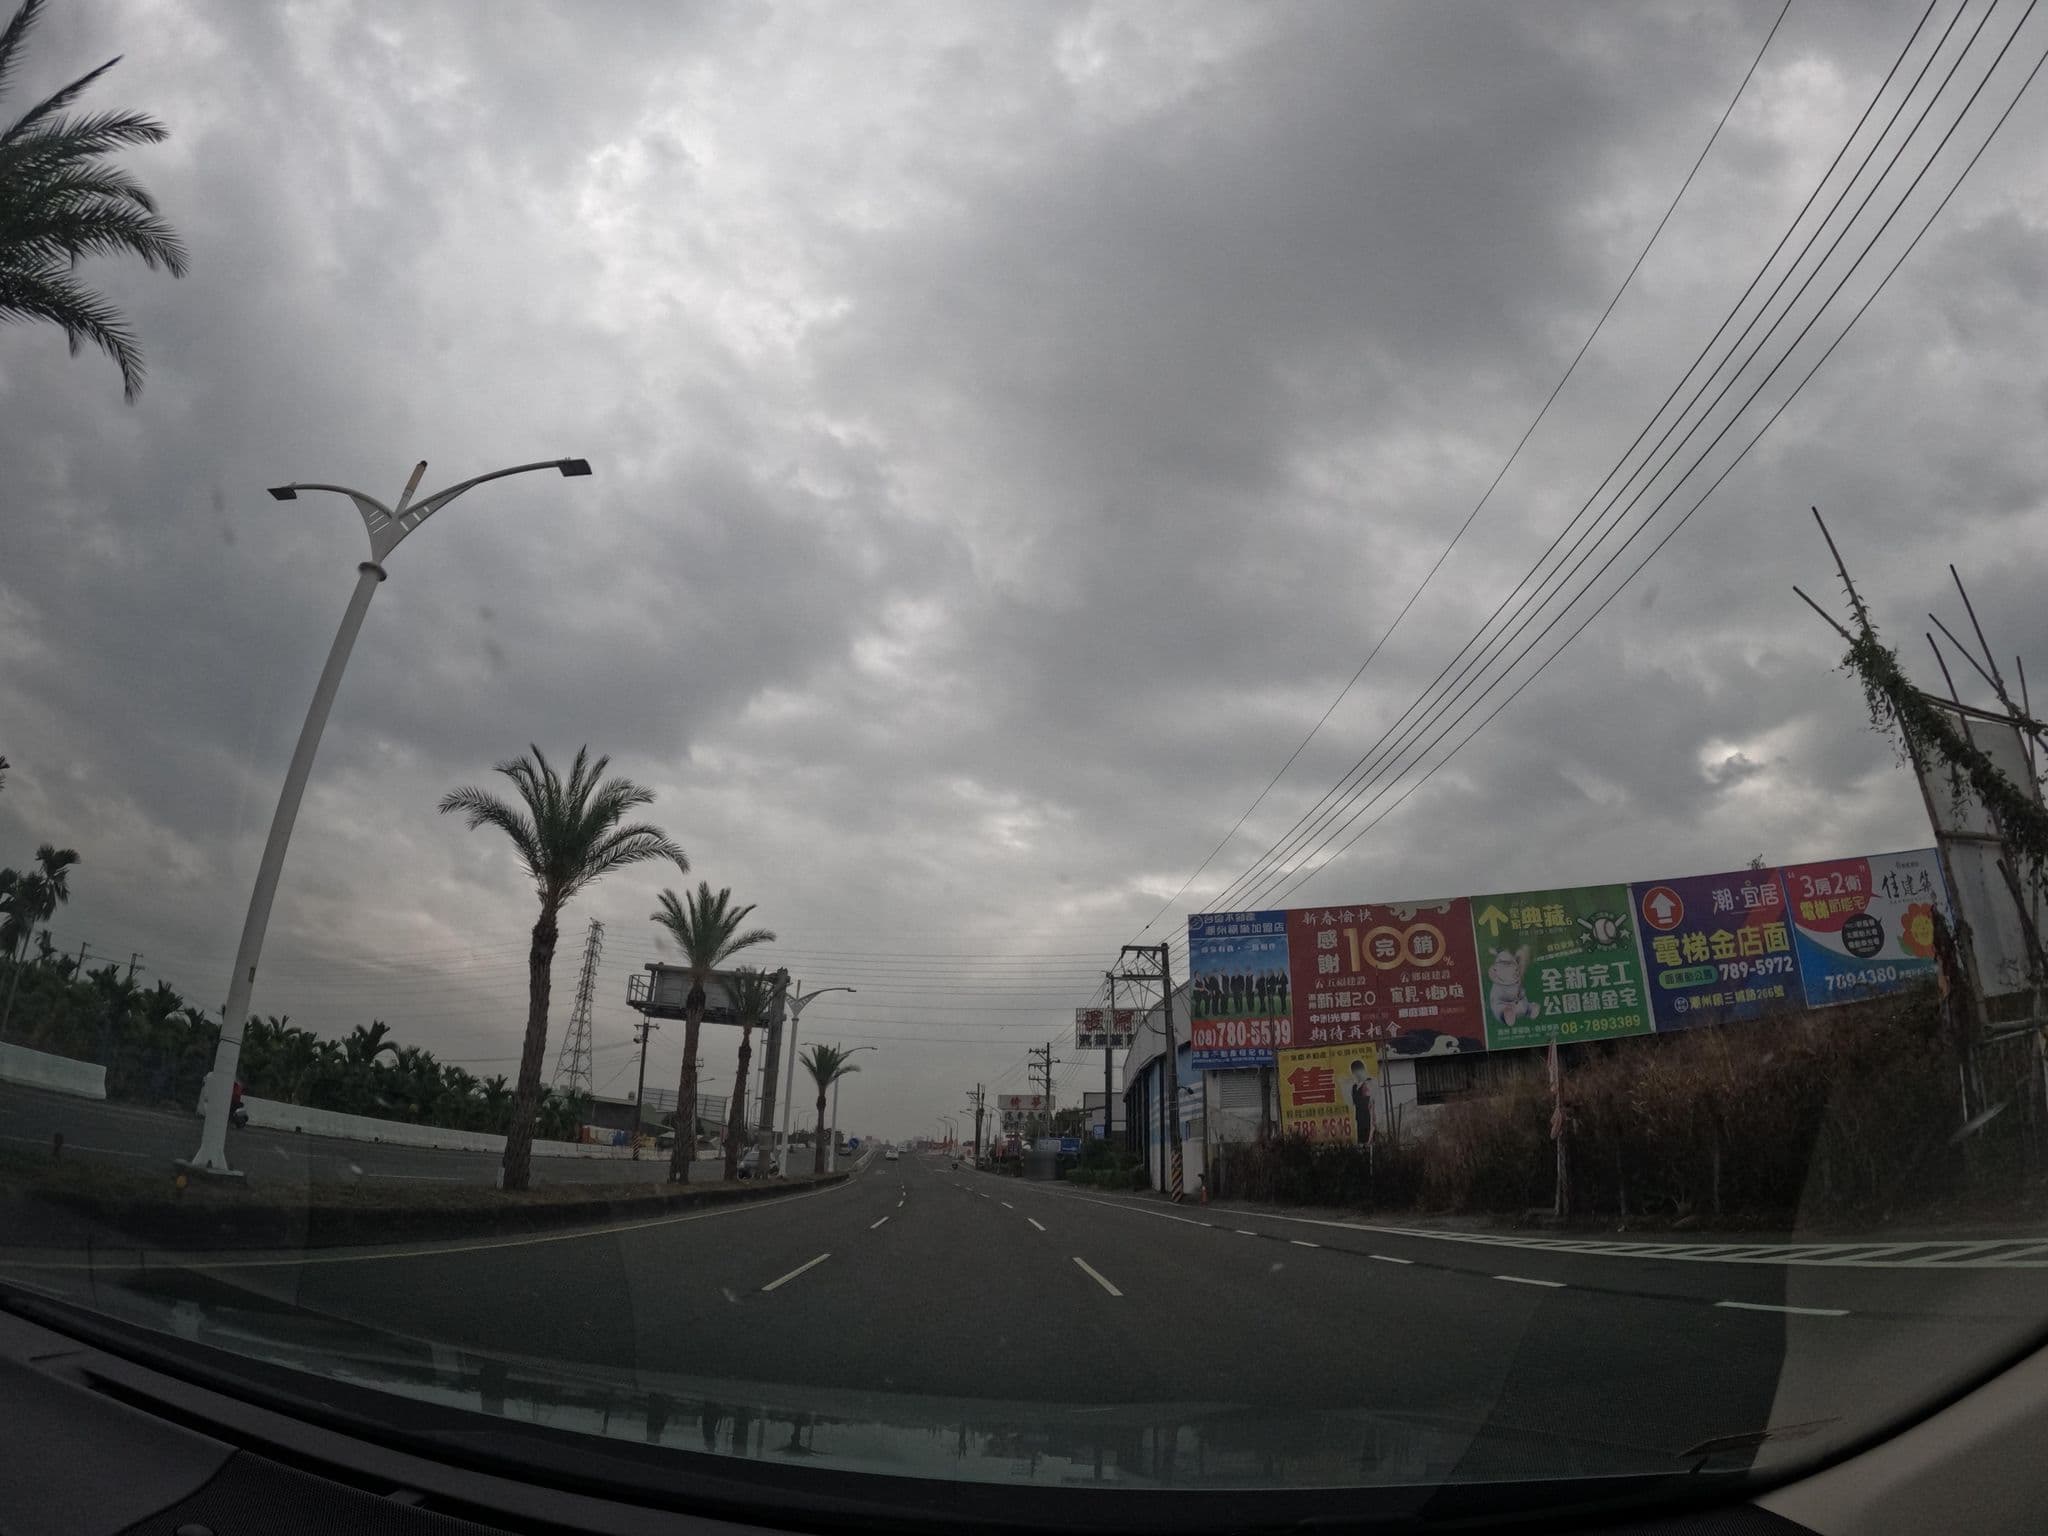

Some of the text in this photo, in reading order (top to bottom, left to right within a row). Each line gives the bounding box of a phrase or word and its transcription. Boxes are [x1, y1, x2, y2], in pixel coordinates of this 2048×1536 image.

[1652, 922, 1790, 966] 電梯金店面
[1541, 961, 1634, 992] 全新完工
[1719, 956, 1793, 986] 789-5972
[1543, 988, 1638, 1016] 公園綠金宅
